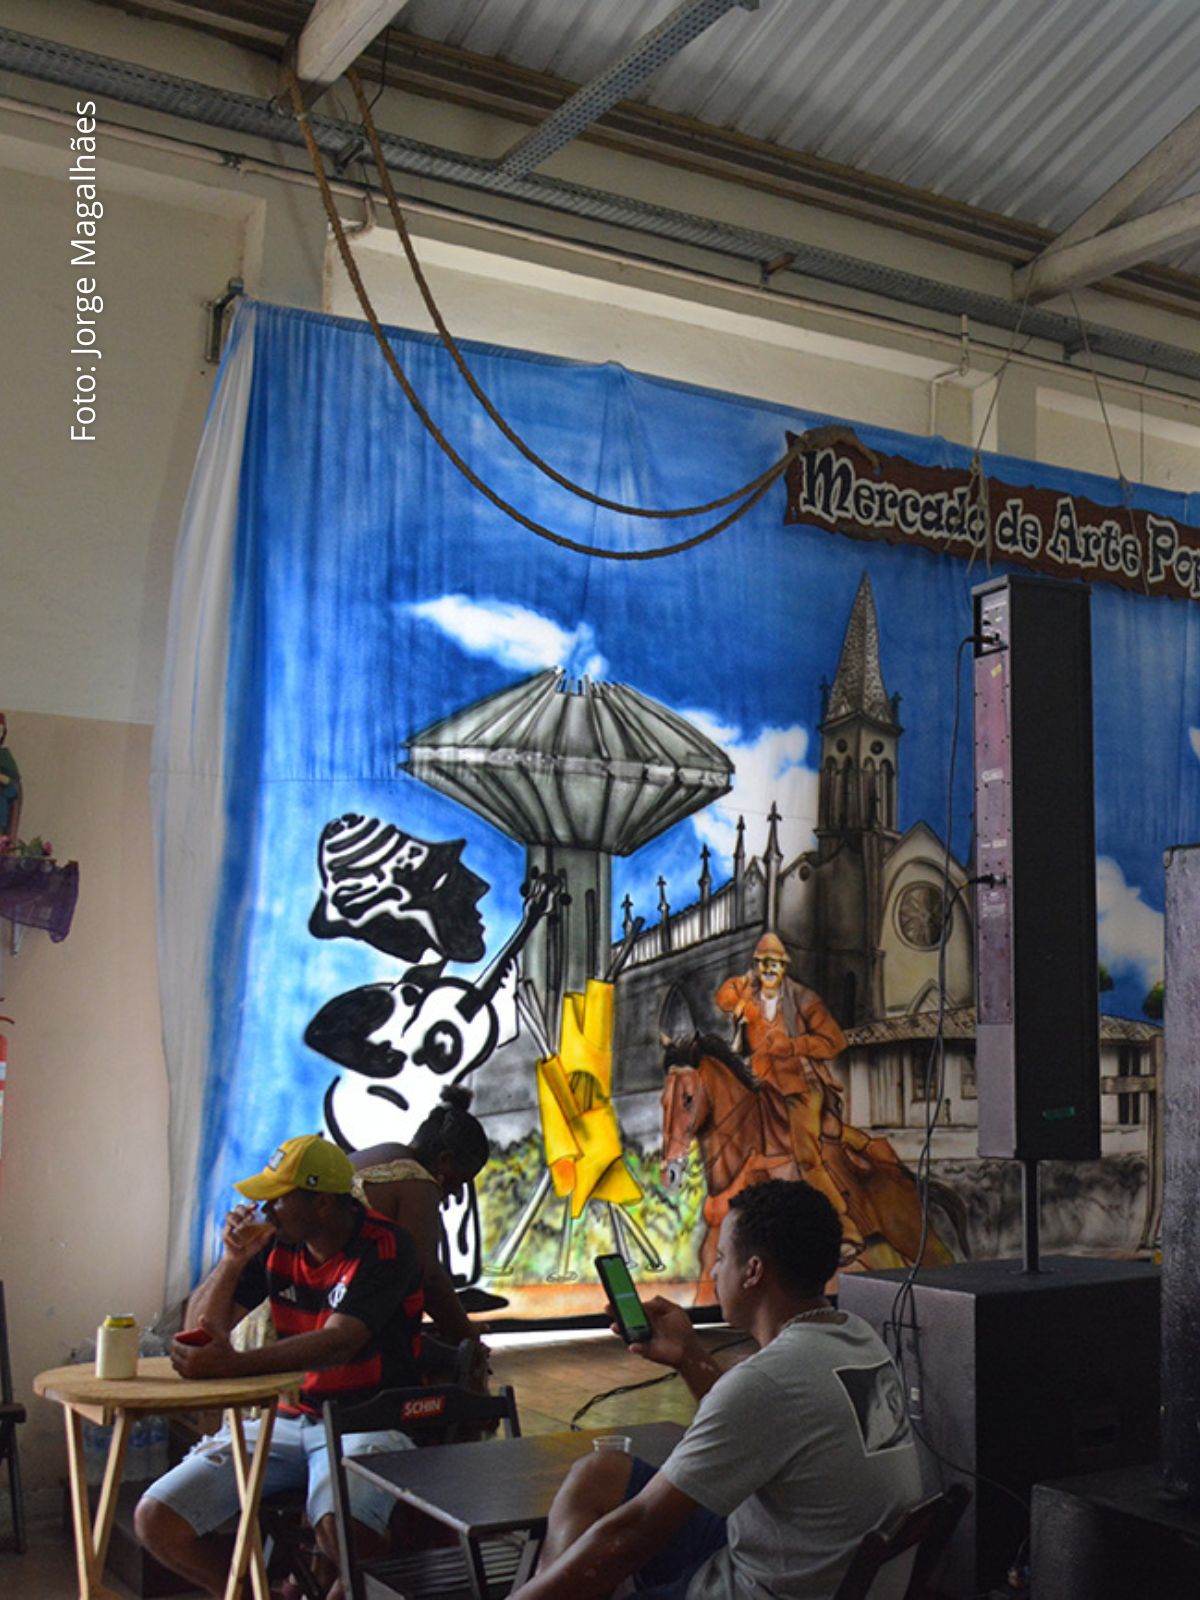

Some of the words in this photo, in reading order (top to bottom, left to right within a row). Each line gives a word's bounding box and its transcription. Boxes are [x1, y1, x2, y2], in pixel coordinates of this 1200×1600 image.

[799, 447, 988, 548] Mercado
[995, 498, 1042, 557] de
[1046, 496, 1141, 577] Arte
